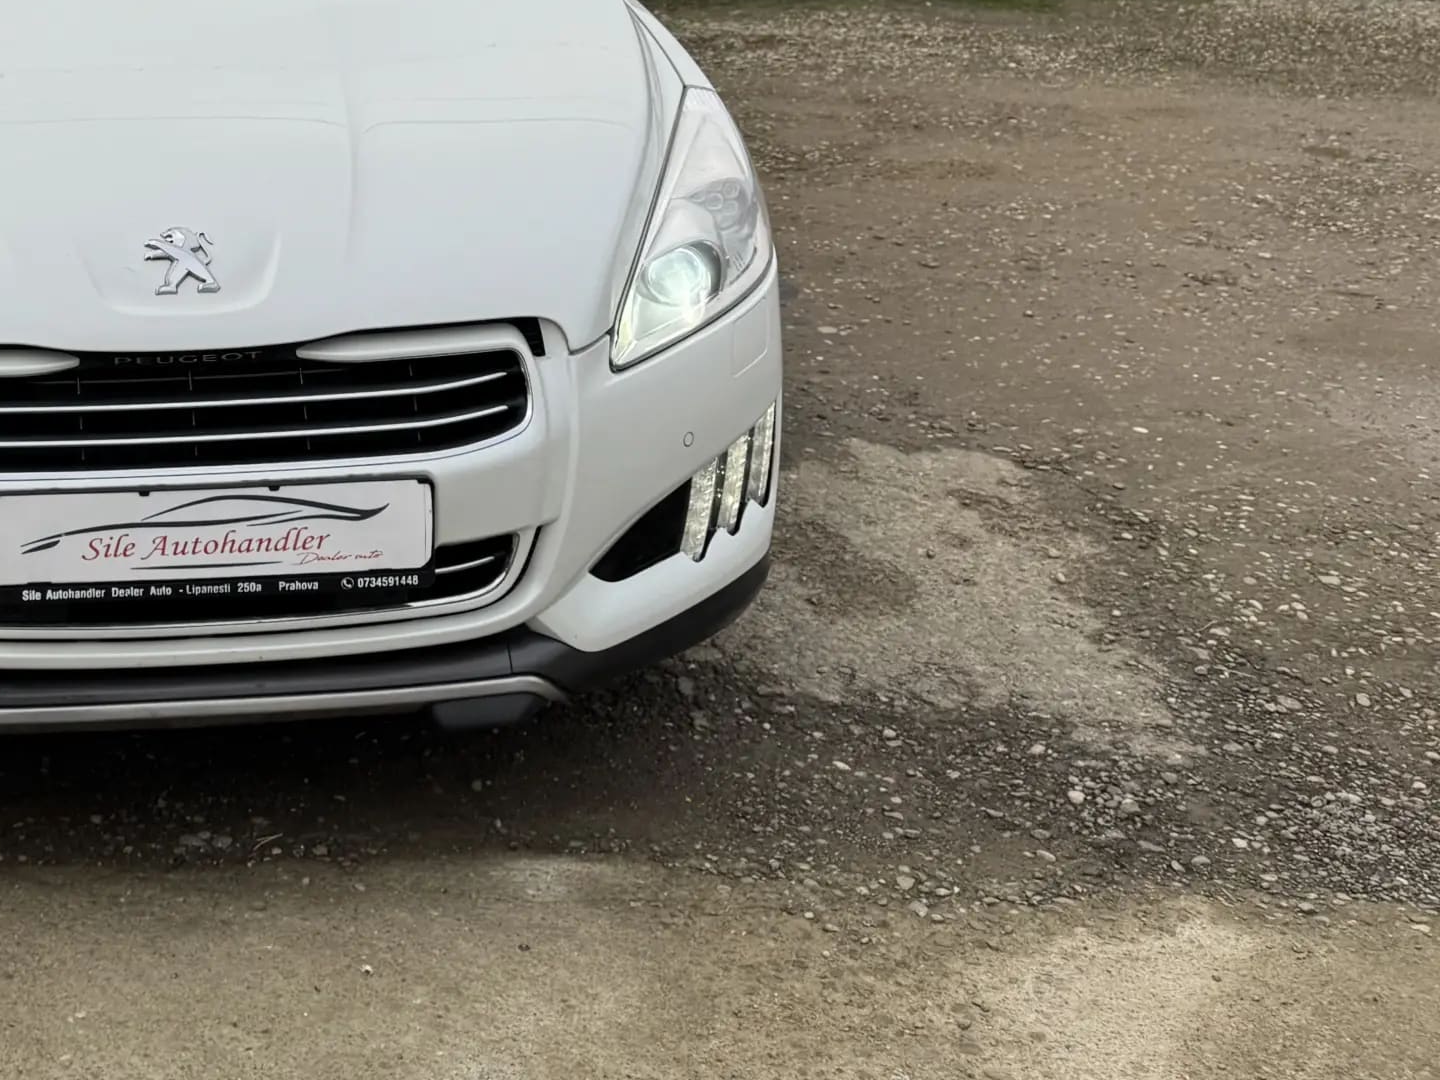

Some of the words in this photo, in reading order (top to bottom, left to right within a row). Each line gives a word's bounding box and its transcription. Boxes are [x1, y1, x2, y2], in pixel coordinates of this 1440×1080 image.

[114, 351, 262, 365] PEUGEOT
[81, 533, 137, 561] Sile
[140, 526, 331, 561] Autohandler
[22, 589, 42, 601] Sile
[45, 588, 106, 600] Autohandler
[111, 586, 145, 598] Dealer
[149, 585, 173, 596] Auto
[237, 582, 262, 593] 250a
[278, 580, 319, 592] Prahova
[357, 575, 419, 588] 0734591448
